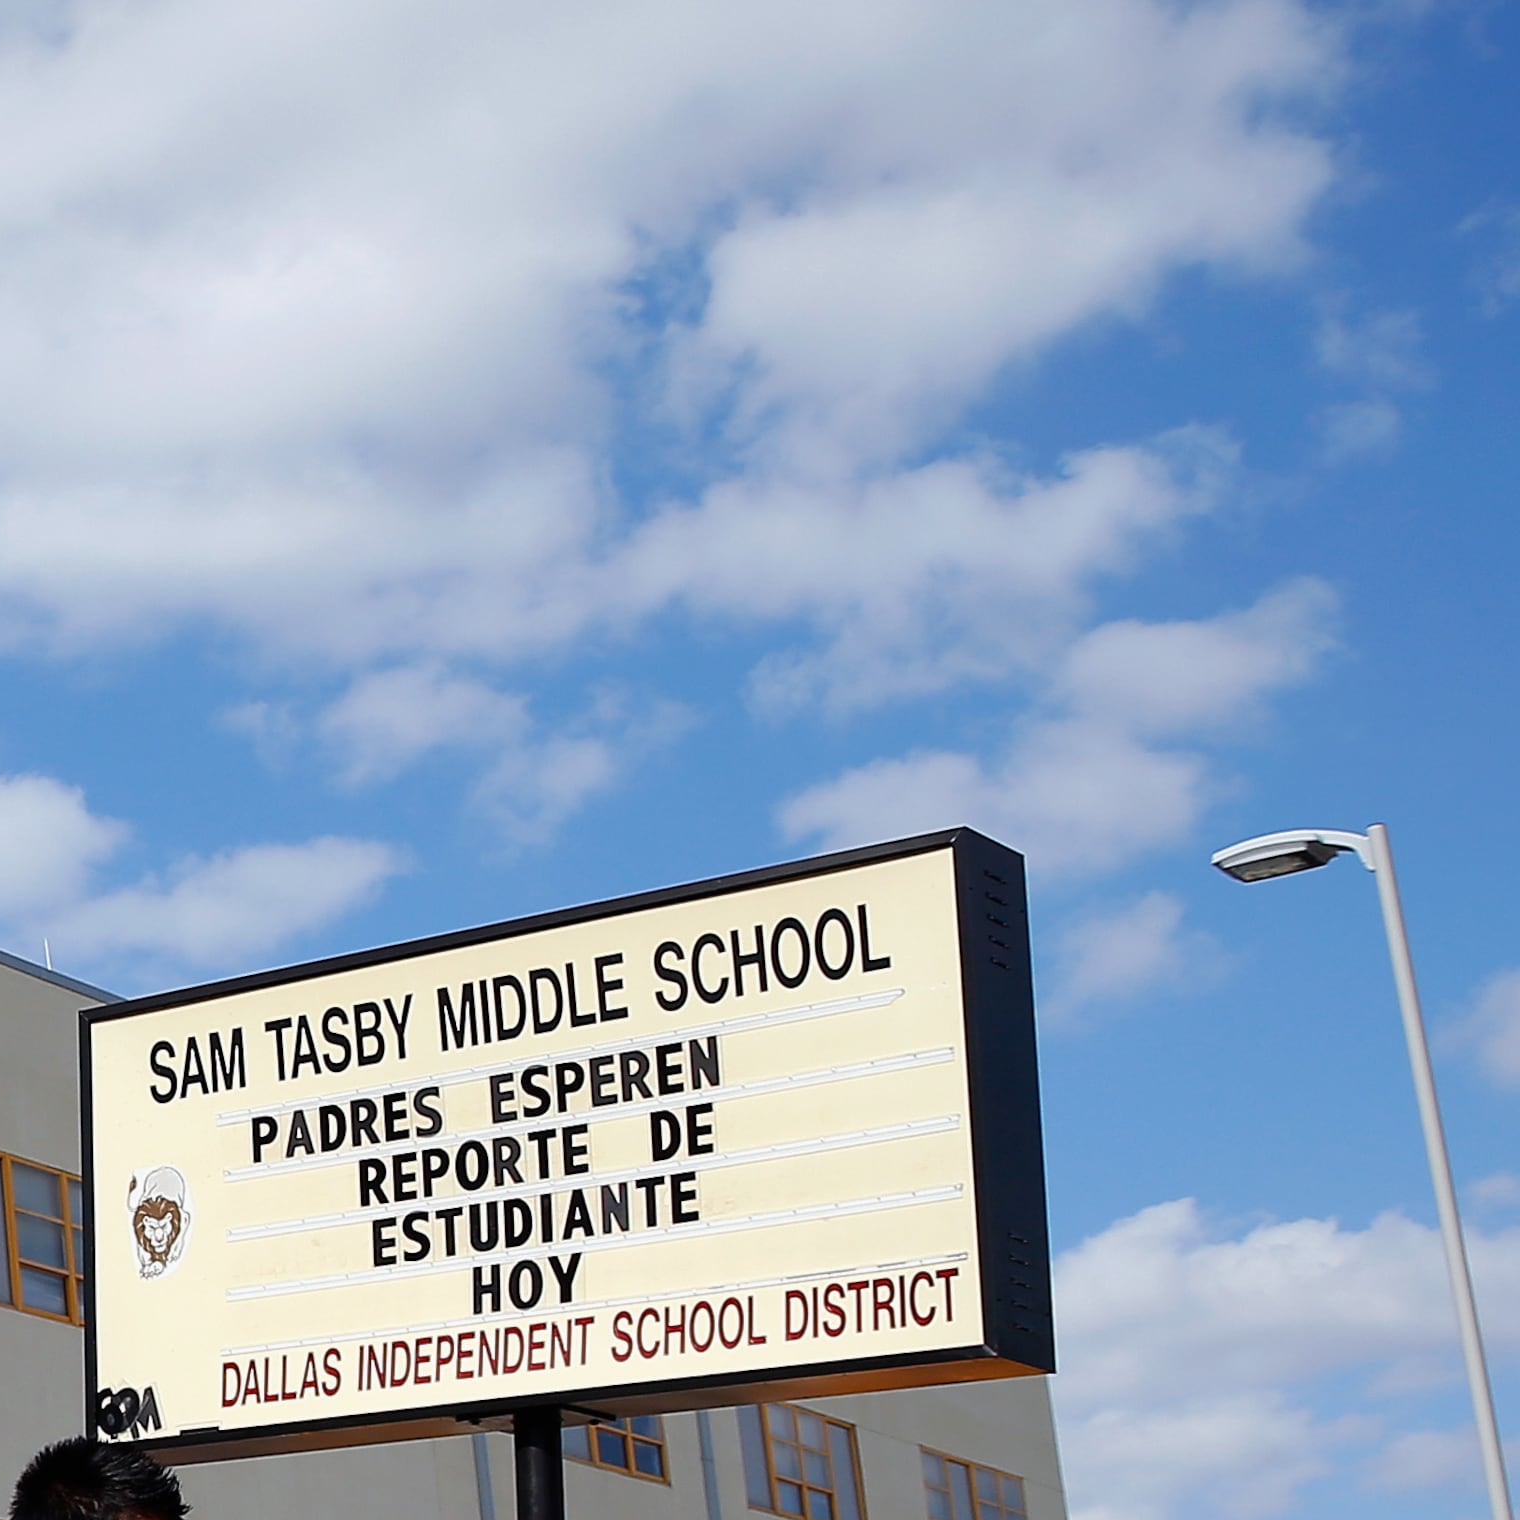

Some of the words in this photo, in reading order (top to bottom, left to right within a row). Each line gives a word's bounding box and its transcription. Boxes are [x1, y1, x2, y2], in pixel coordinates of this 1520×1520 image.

[149, 1026, 247, 1104] SAM
[264, 993, 413, 1082] TASBY
[436, 952, 629, 1052] MIDDLE
[653, 903, 891, 1012] SCHOOL
[251, 1086, 443, 1164] PADRES
[488, 1035, 721, 1125] ESPEREN
[358, 1123, 590, 1208] REPORTE
[649, 1102, 714, 1162] DE
[372, 1170, 700, 1268] ESTUDIANTE
[221, 1347, 342, 1408] DALLAS
[358, 1316, 595, 1391] INDEPENDENT
[611, 1295, 767, 1363] SCHOOL
[785, 1267, 959, 1342] DISTRICT
[472, 1251, 583, 1316] HOY
